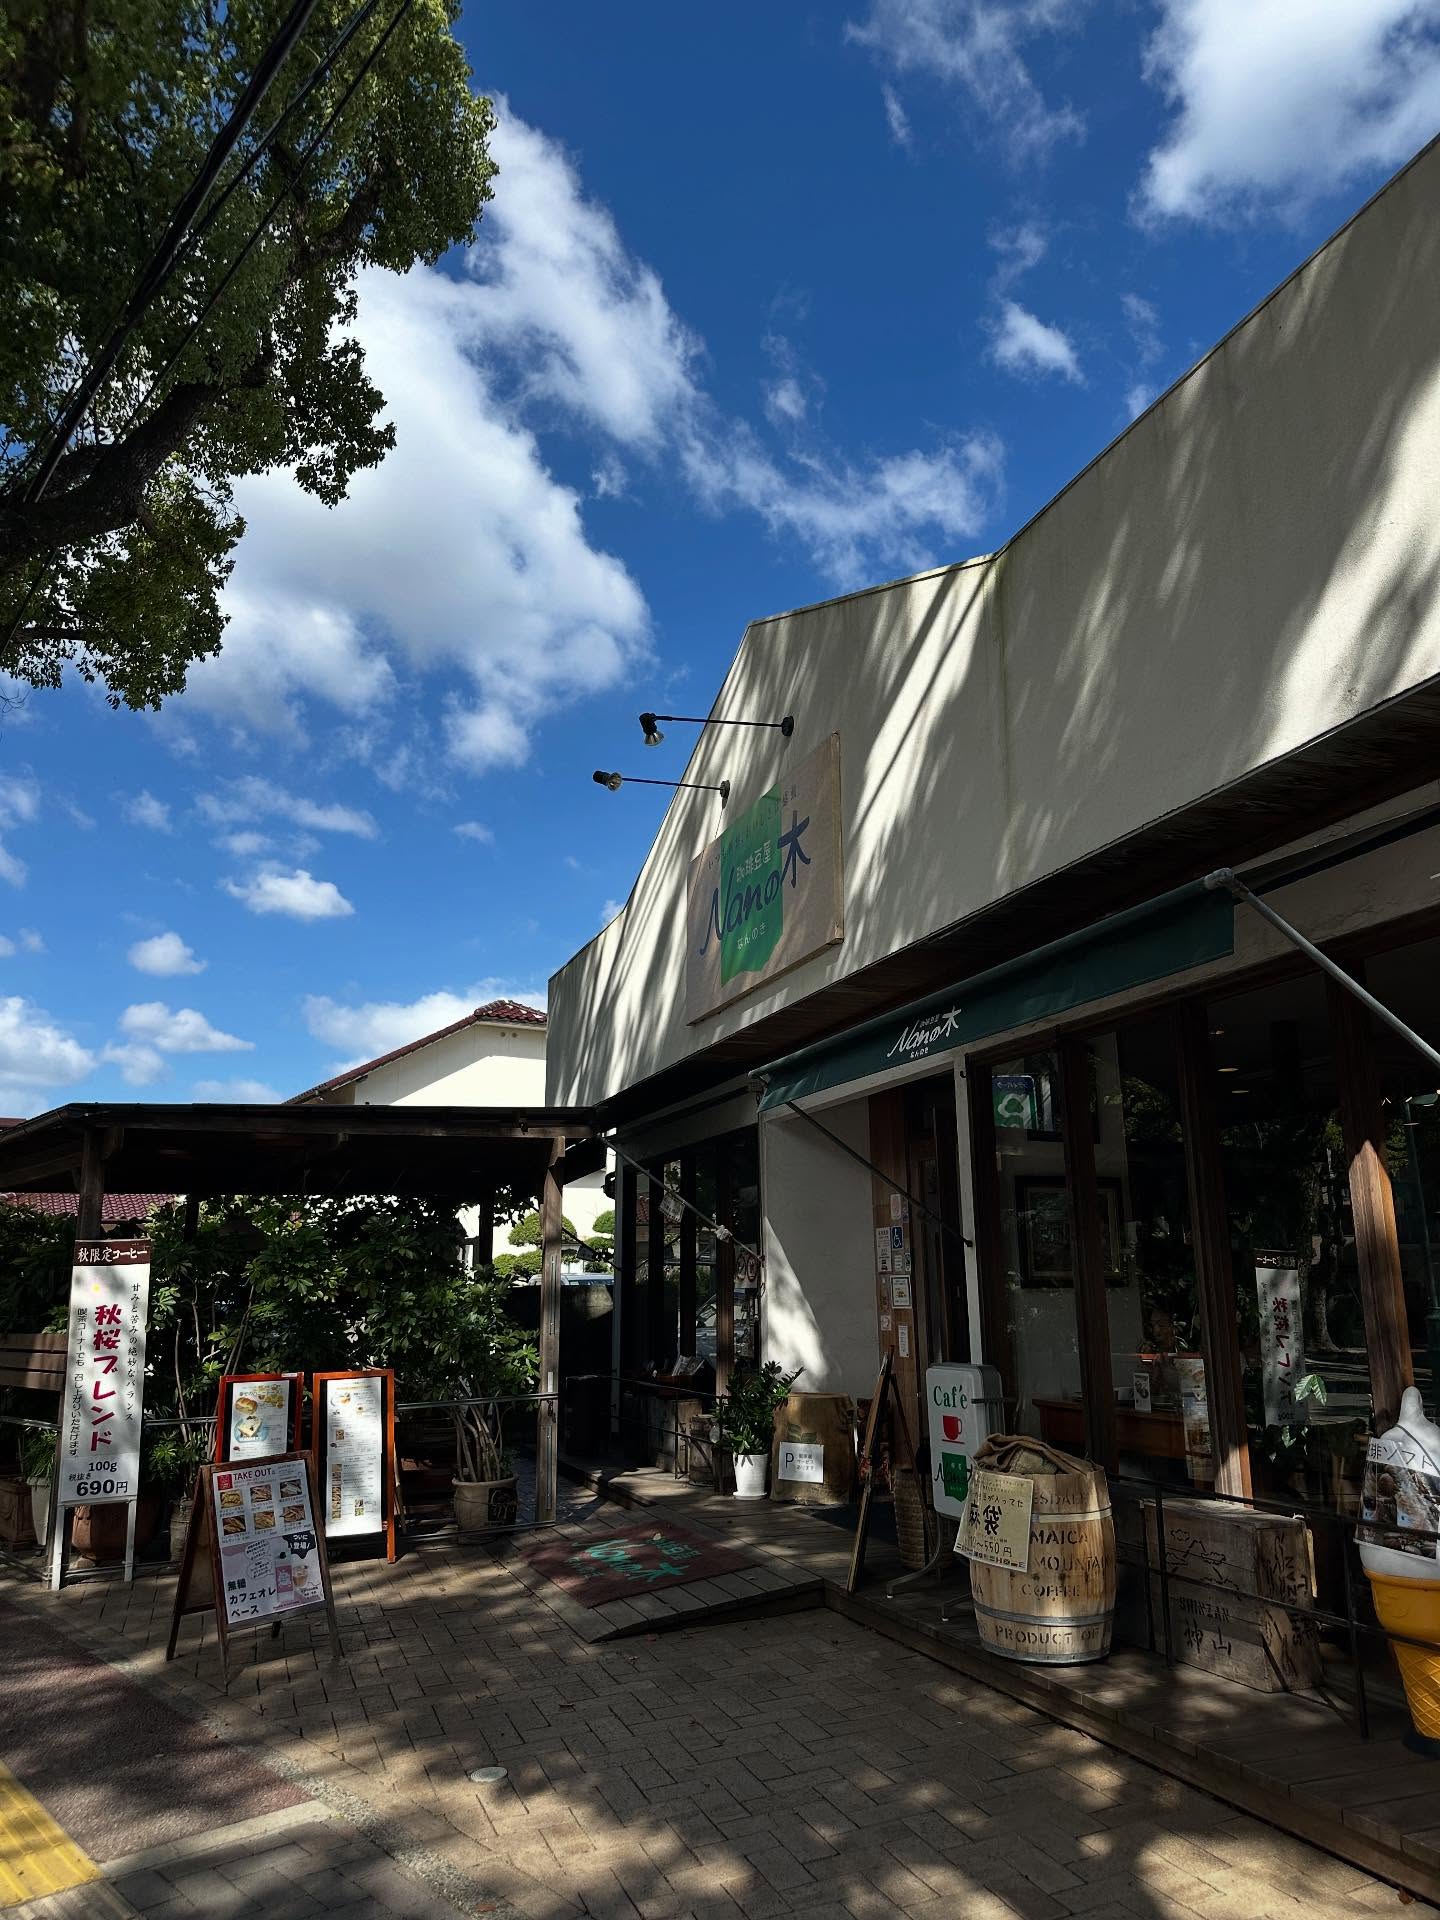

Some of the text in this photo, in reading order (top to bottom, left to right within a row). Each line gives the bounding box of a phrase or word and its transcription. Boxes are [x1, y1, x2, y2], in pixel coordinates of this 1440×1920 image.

[77, 1246, 148, 1263] 秋限定コーヒー
[91, 1304, 122, 1452] 秋桜ブレンド
[933, 1384, 968, 1409] Café
[88, 1461, 118, 1473] 100g
[785, 1452, 795, 1470] P
[233, 1471, 253, 1481] TAKE
[254, 1467, 272, 1478] OUT
[76, 1480, 129, 1497] 690円
[229, 1587, 277, 1605] カフェオレ
[1021, 1583, 1080, 1598] COFFEE
[994, 1625, 1073, 1645] PRODUCT
